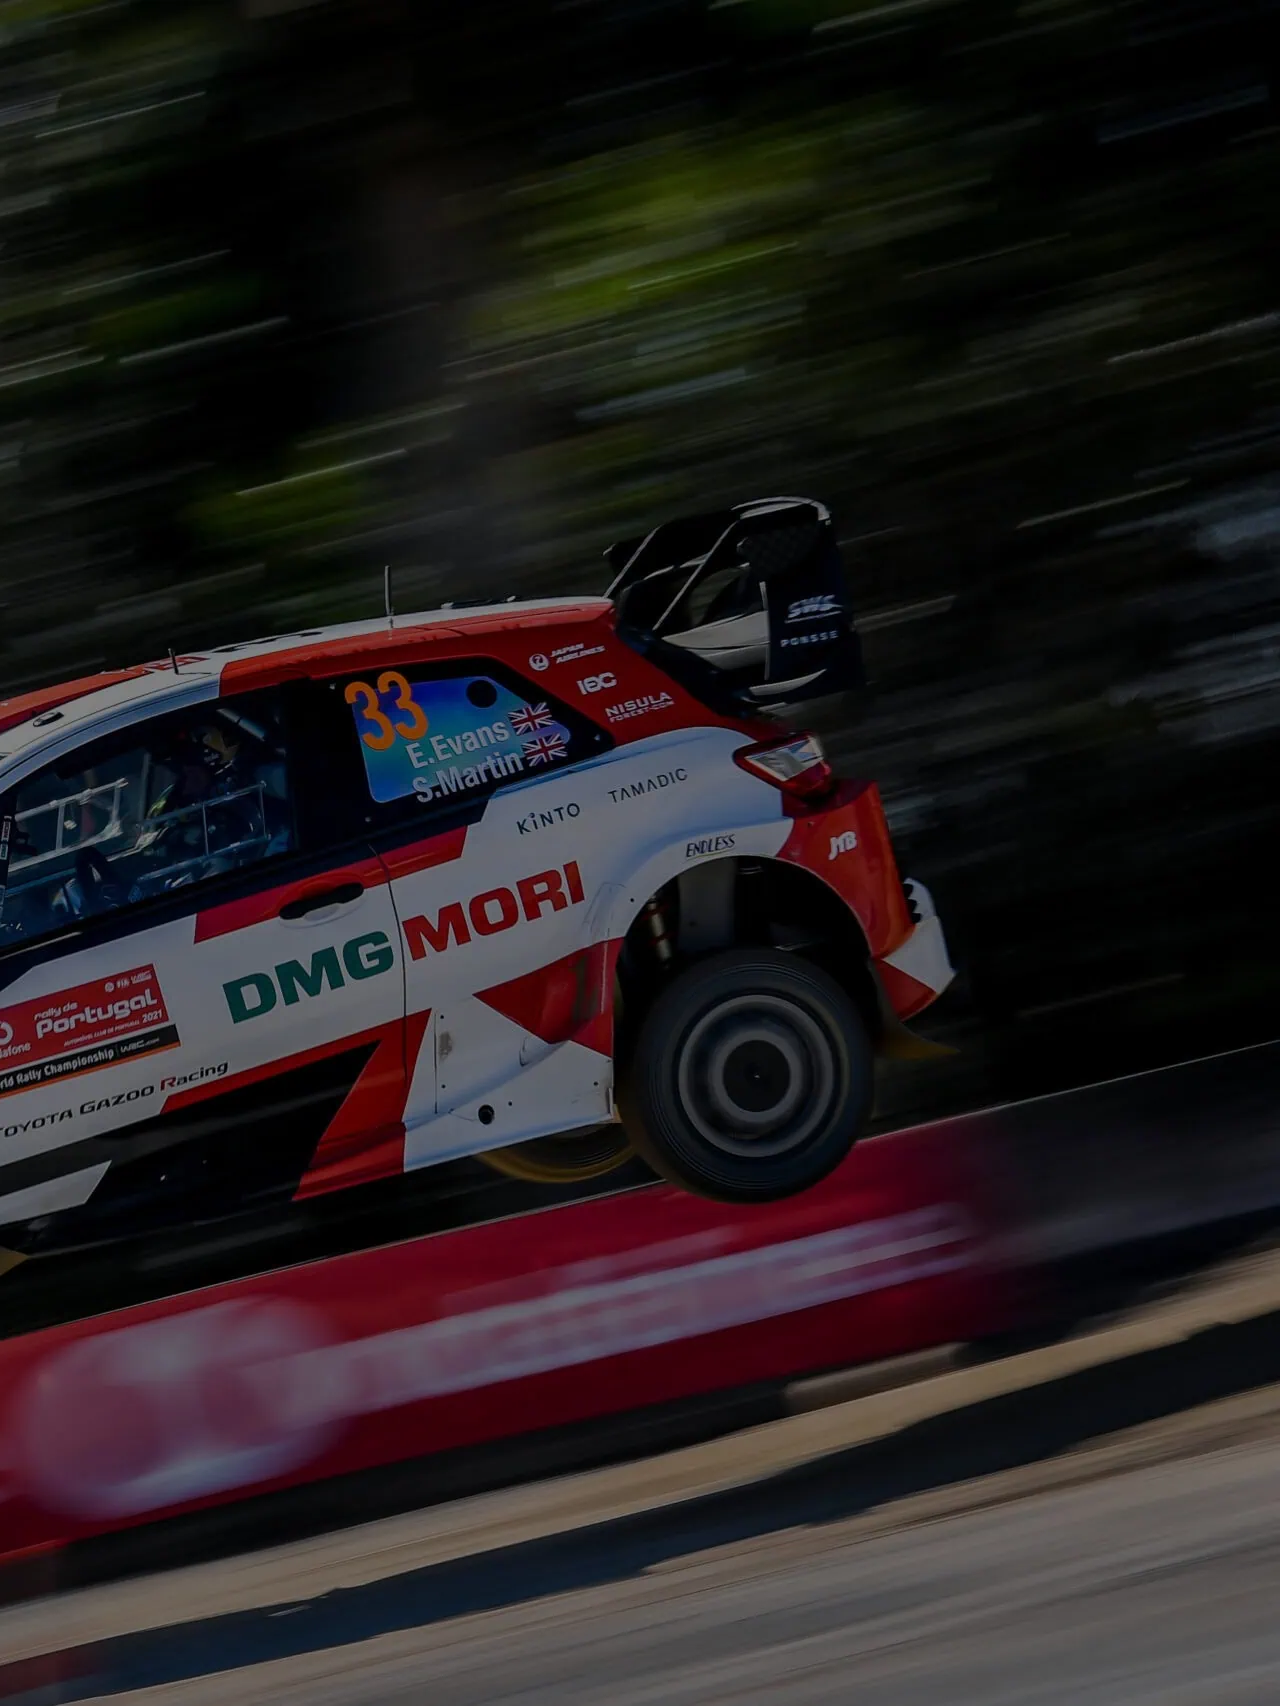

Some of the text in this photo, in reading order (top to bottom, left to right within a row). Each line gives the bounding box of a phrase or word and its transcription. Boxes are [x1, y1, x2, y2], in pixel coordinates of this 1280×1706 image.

[344, 671, 428, 750] 33
[605, 692, 673, 717] NISULA
[406, 721, 509, 768] E.Evans
[413, 750, 524, 803] S.Martin
[608, 768, 688, 803] TAMADIC
[686, 833, 735, 858] ENDLESS
[222, 861, 585, 1024] DMG MORI
[33, 1001, 79, 1021] rally de
[35, 988, 158, 1039] Portugal
[142, 1009, 163, 1024] 2021
[17, 1067, 42, 1087] Rally
[44, 1046, 114, 1079] Championship
[80, 1086, 154, 1114] GAZOO
[160, 1062, 228, 1092] Racing
